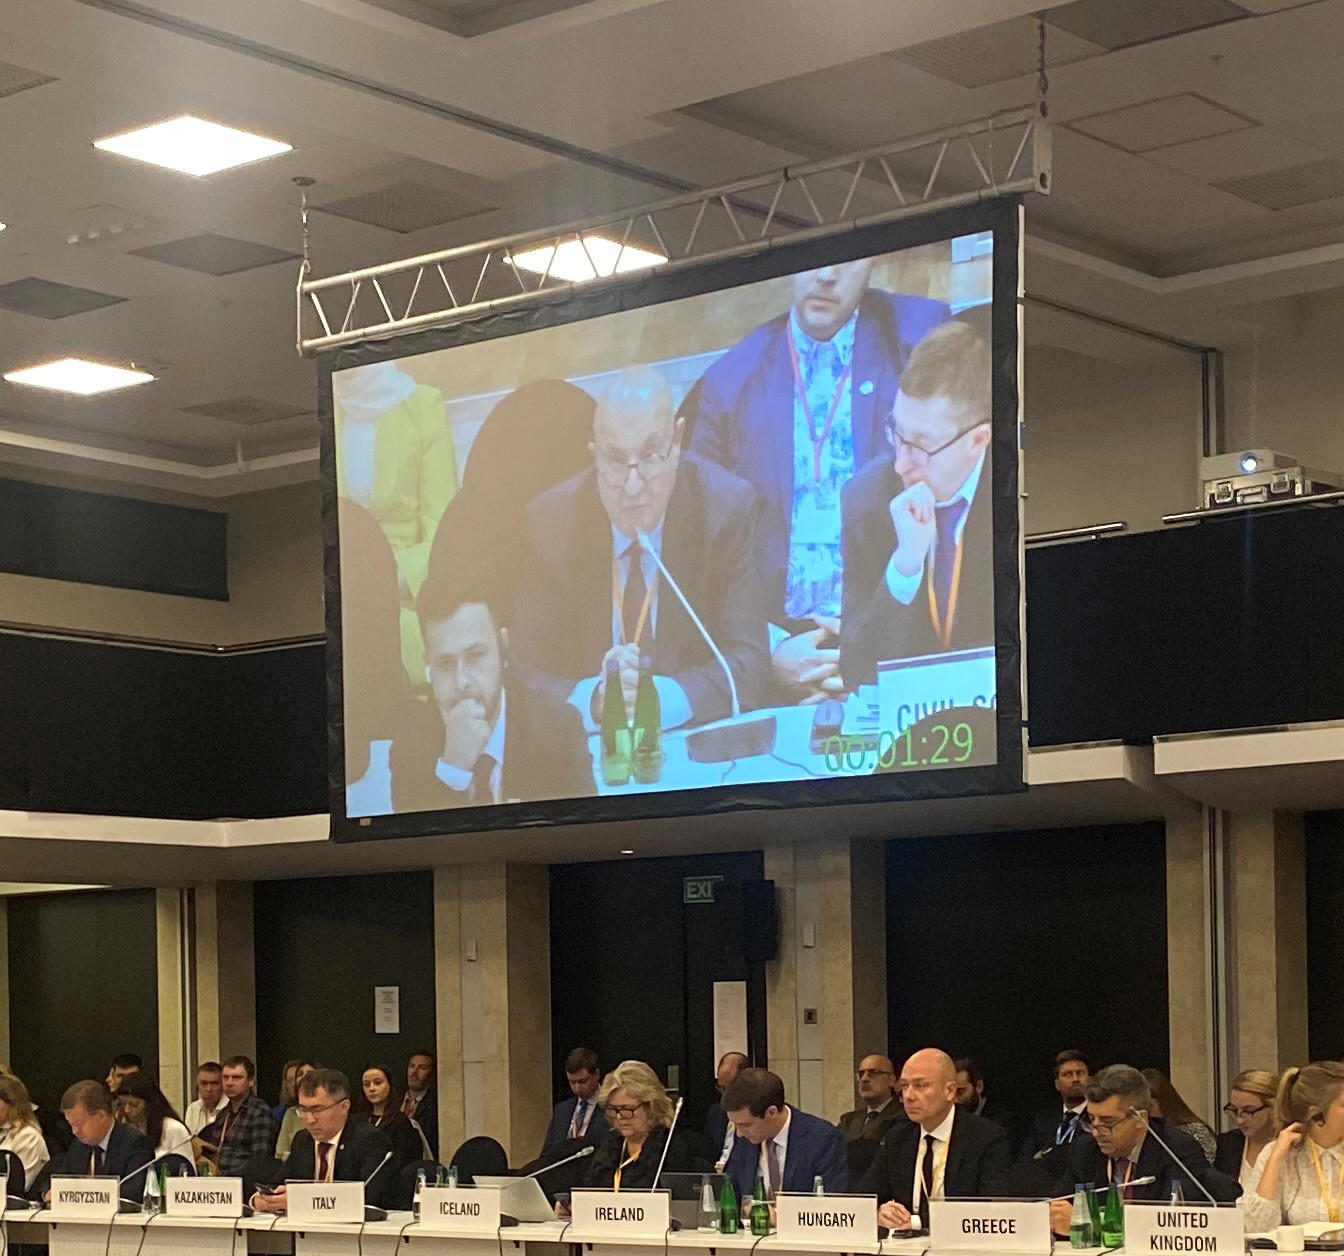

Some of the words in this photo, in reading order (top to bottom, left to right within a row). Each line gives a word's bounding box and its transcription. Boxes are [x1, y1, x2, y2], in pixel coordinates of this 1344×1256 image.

[825, 723, 973, 772] 00:01:29
[686, 880, 713, 899] EXI
[58, 1190, 110, 1204] KYRGYZSTAN
[174, 1191, 233, 1205] KAZAKHSTAN
[312, 1196, 337, 1210] ITALY
[439, 1201, 480, 1217] ICELAND
[595, 1206, 645, 1222] IRELAND
[797, 1211, 856, 1228] HUNGARY
[961, 1218, 1017, 1234] GREECE
[1157, 1211, 1209, 1229] UNITED
[1150, 1234, 1217, 1252] KINGDOM
